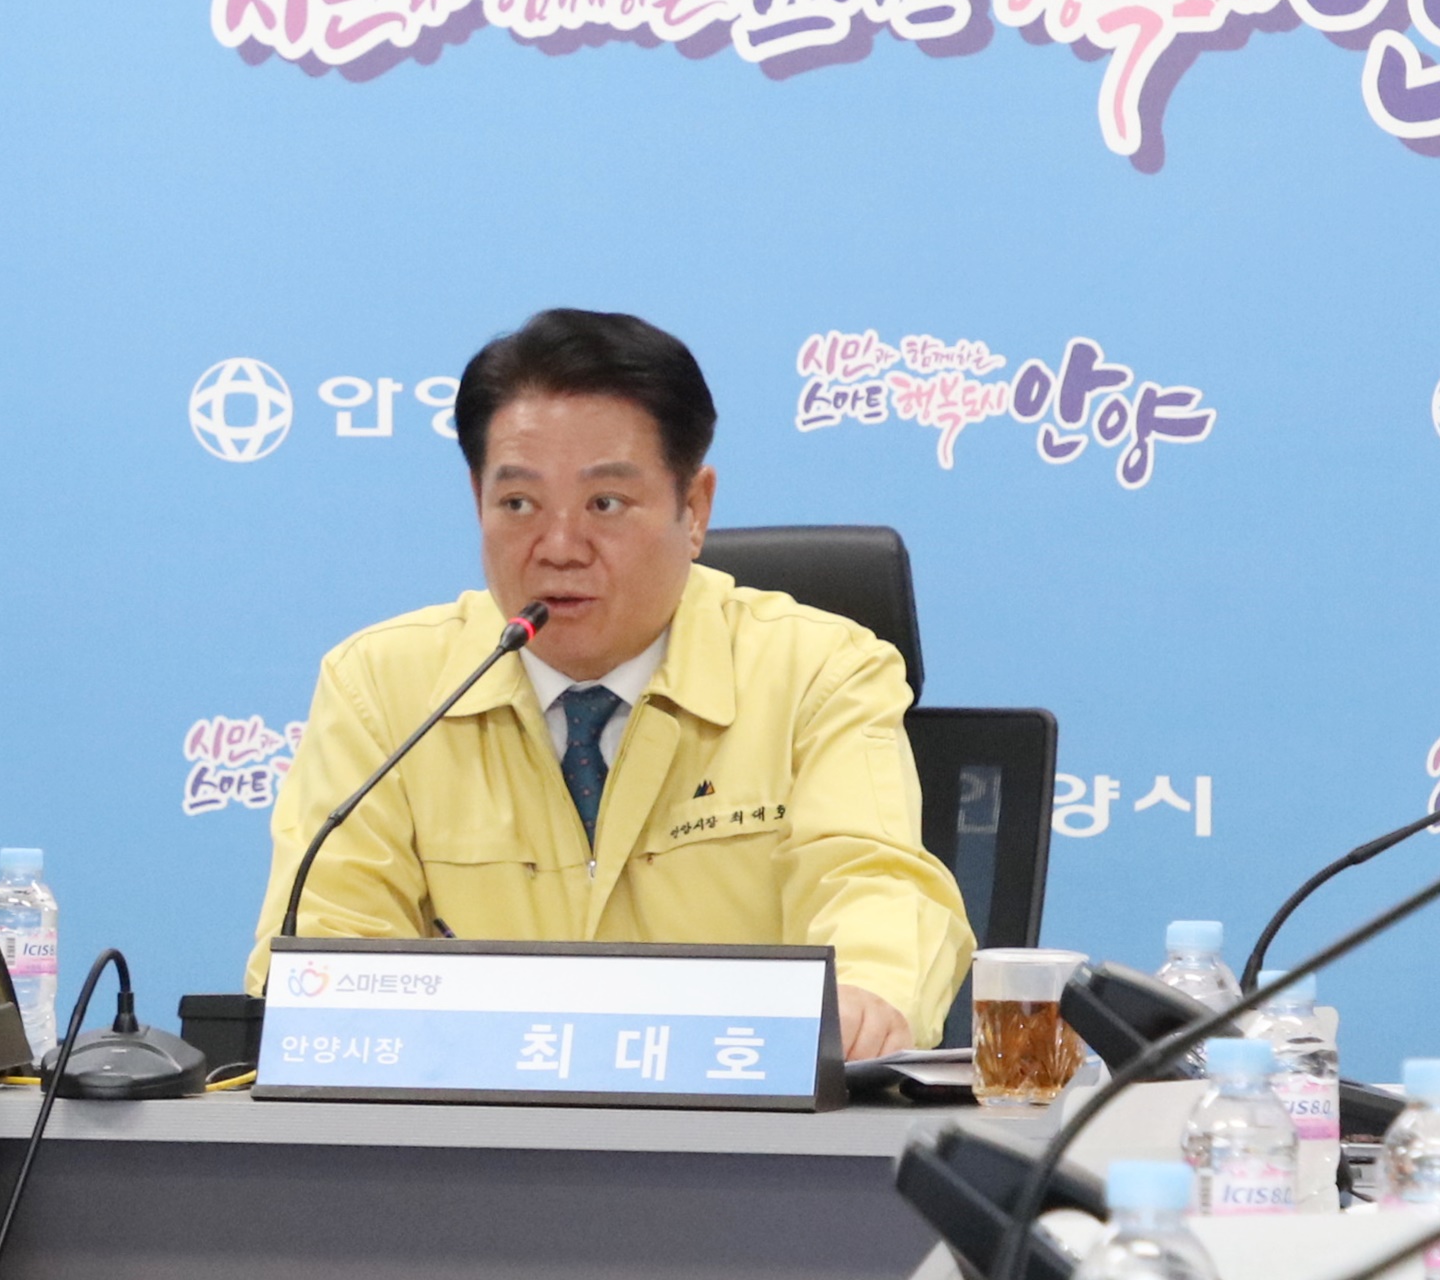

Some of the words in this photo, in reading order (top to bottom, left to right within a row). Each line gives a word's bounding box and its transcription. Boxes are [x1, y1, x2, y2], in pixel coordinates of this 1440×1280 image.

[800, 333, 896, 377] 시민과
[801, 380, 884, 427] 스마트
[888, 374, 1008, 466] 행복도시
[1011, 341, 1214, 485] 안양
[187, 720, 281, 763] 시민과
[188, 765, 269, 810] 스마트
[334, 972, 444, 997] 스마트안양
[280, 1034, 405, 1066] 안양시장
